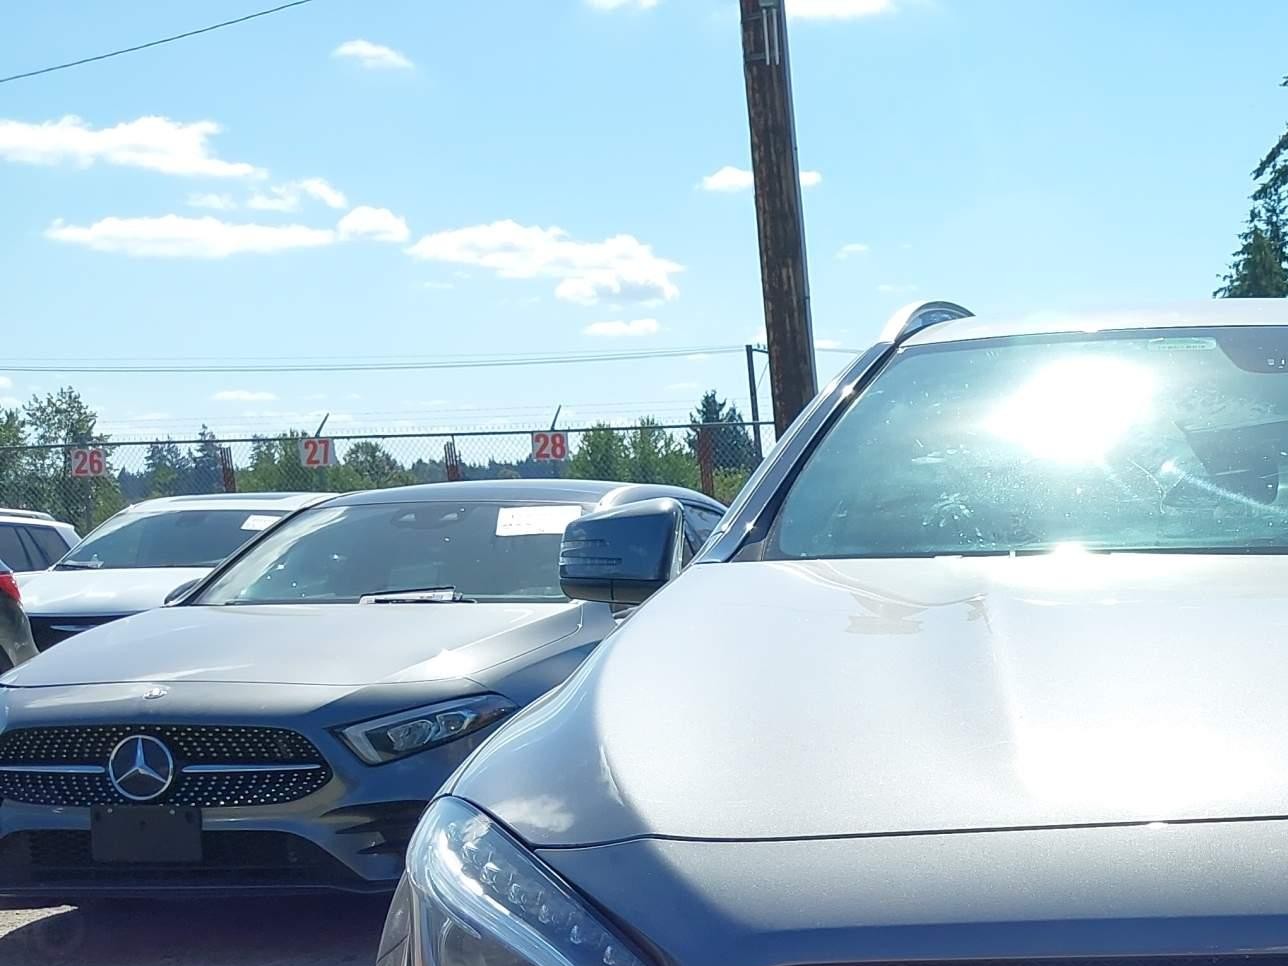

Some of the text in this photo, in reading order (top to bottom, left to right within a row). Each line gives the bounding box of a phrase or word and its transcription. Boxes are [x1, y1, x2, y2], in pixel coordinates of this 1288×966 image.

[304, 440, 330, 465] 27
[534, 433, 566, 459] 28
[74, 450, 104, 475] 26
